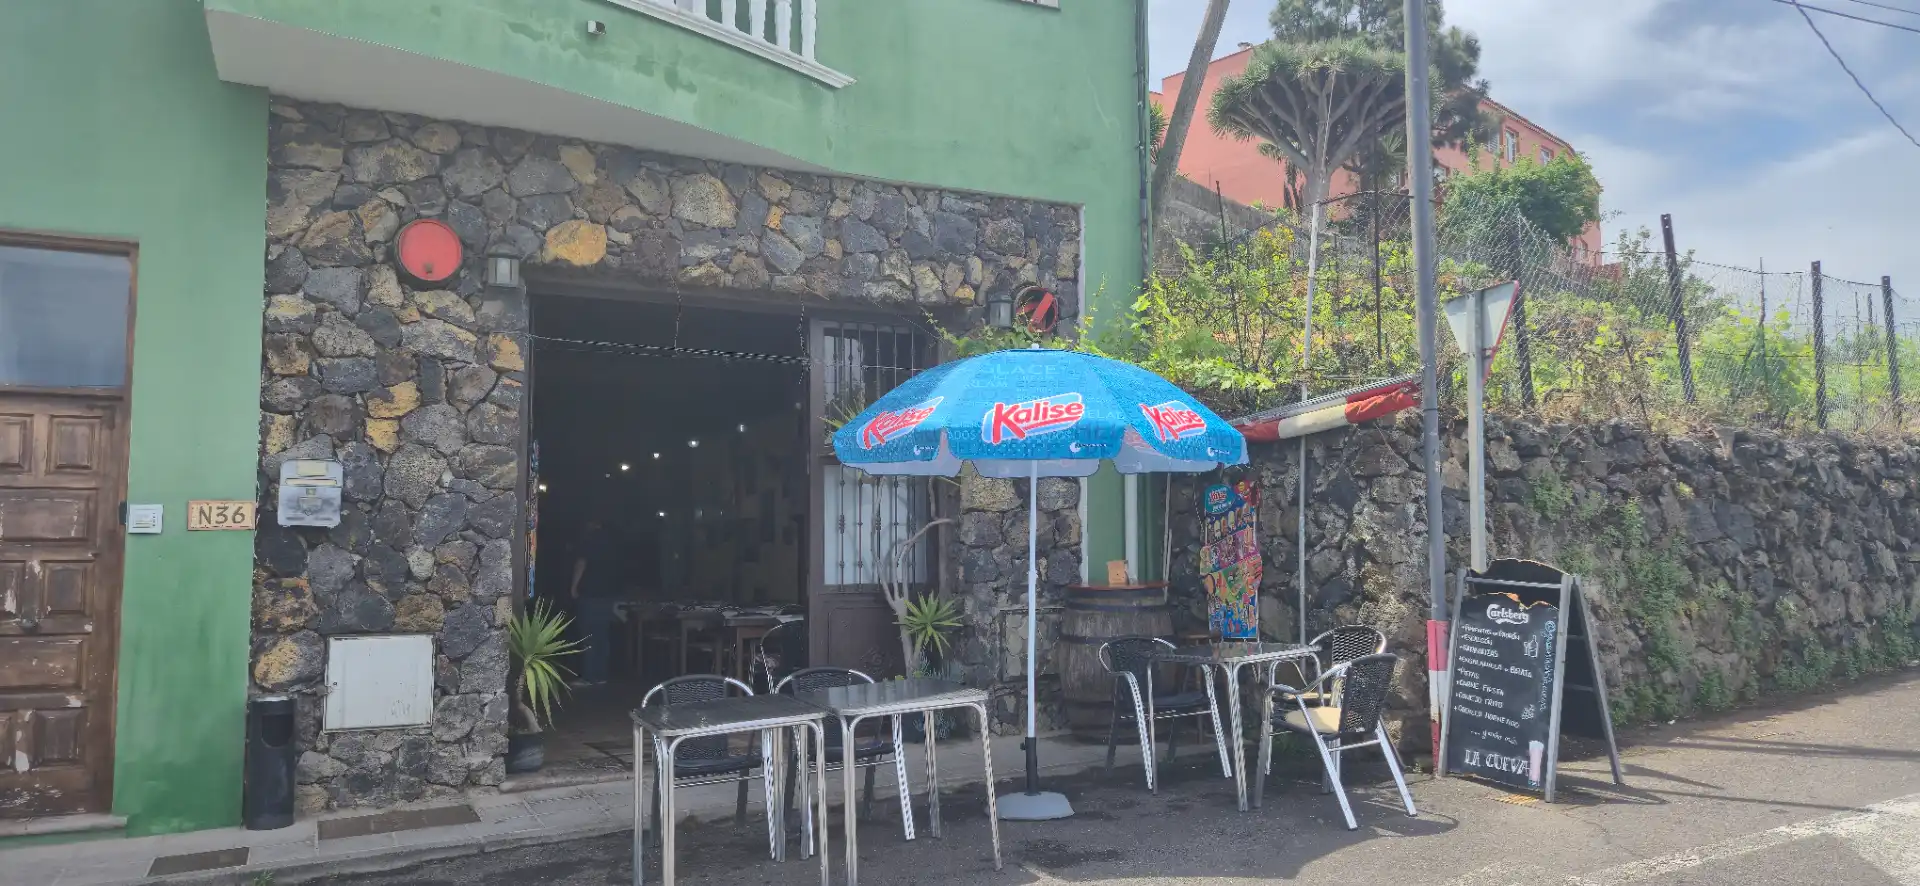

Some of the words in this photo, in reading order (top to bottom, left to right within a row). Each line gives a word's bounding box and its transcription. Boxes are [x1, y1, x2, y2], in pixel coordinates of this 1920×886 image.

[863, 406, 935, 450] Kalise
[991, 401, 1085, 445] Kalise
[1138, 402, 1206, 444] Kalise
[199, 505, 246, 525] N36
[1486, 603, 1530, 625] Carlsberg
[1459, 679, 1480, 690] CARNE
[1482, 684, 1504, 696] FIESTA
[1459, 691, 1482, 704] CONEJO
[1484, 698, 1504, 709] FRITO
[1464, 749, 1481, 767] LA
[1485, 753, 1530, 777] CUEVA
